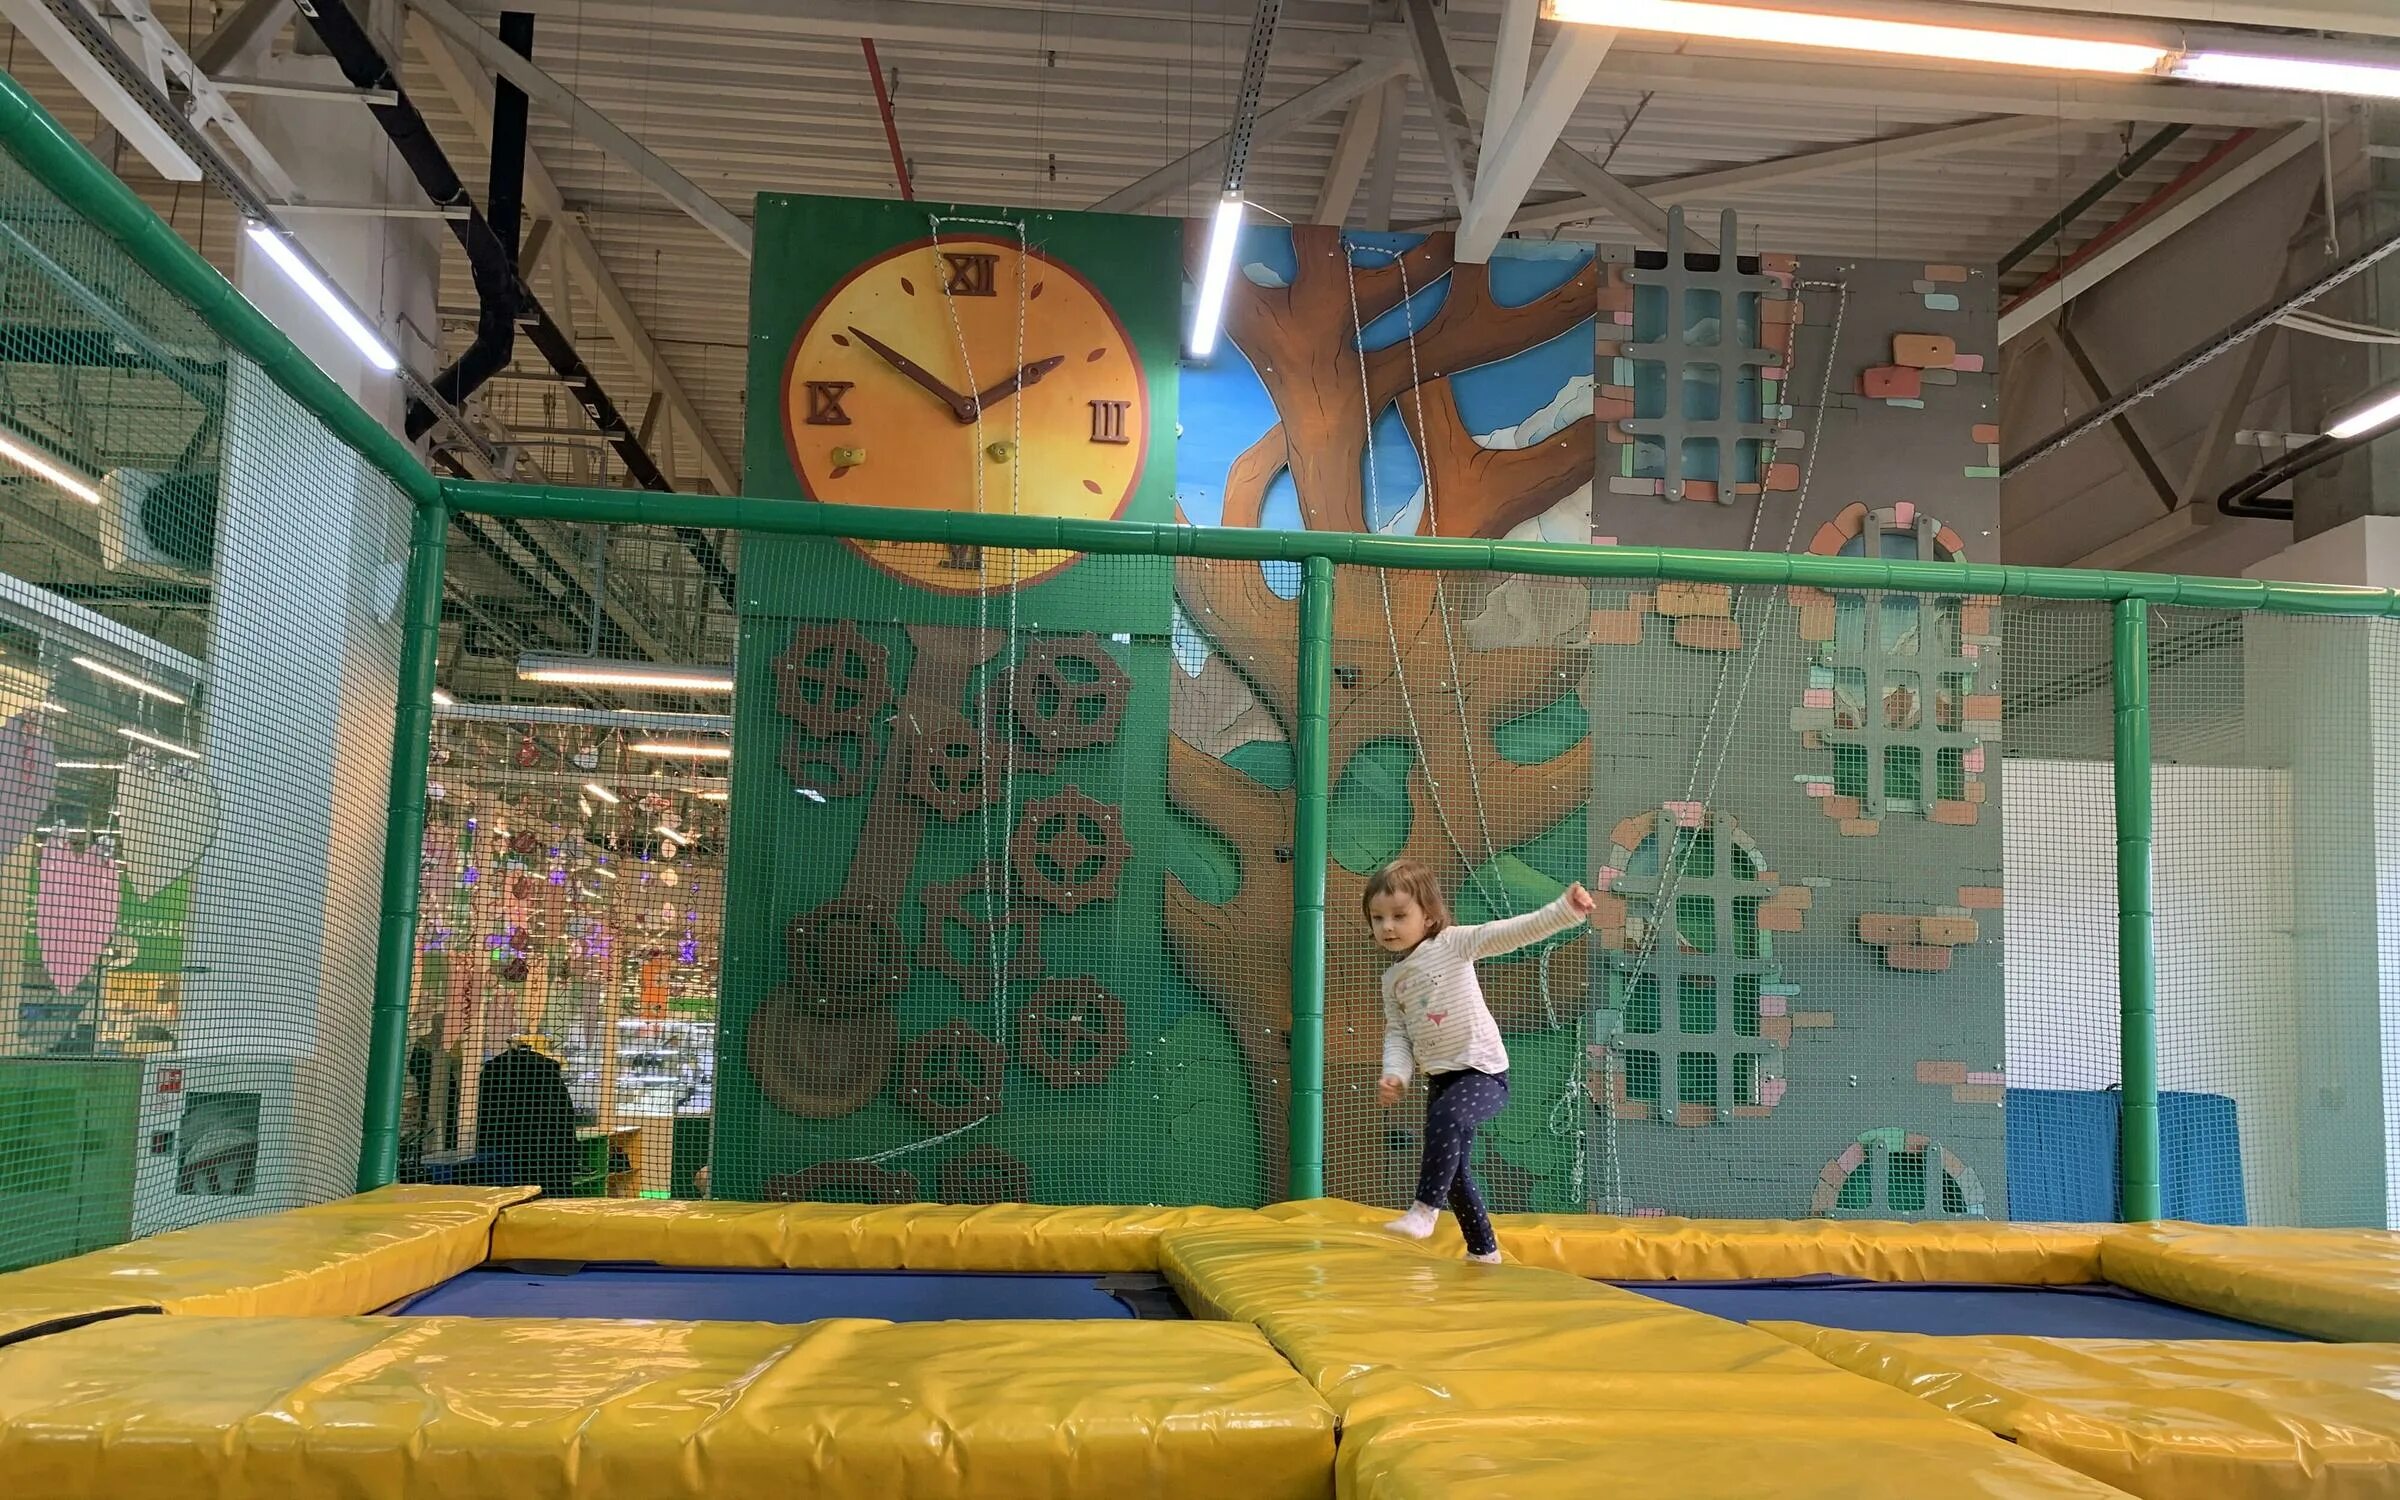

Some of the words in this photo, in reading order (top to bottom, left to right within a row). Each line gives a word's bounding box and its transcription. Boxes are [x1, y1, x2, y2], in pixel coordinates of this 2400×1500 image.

[943, 253, 1000, 297] XII
[804, 380, 855, 426] IX
[1087, 399, 1131, 446] III
